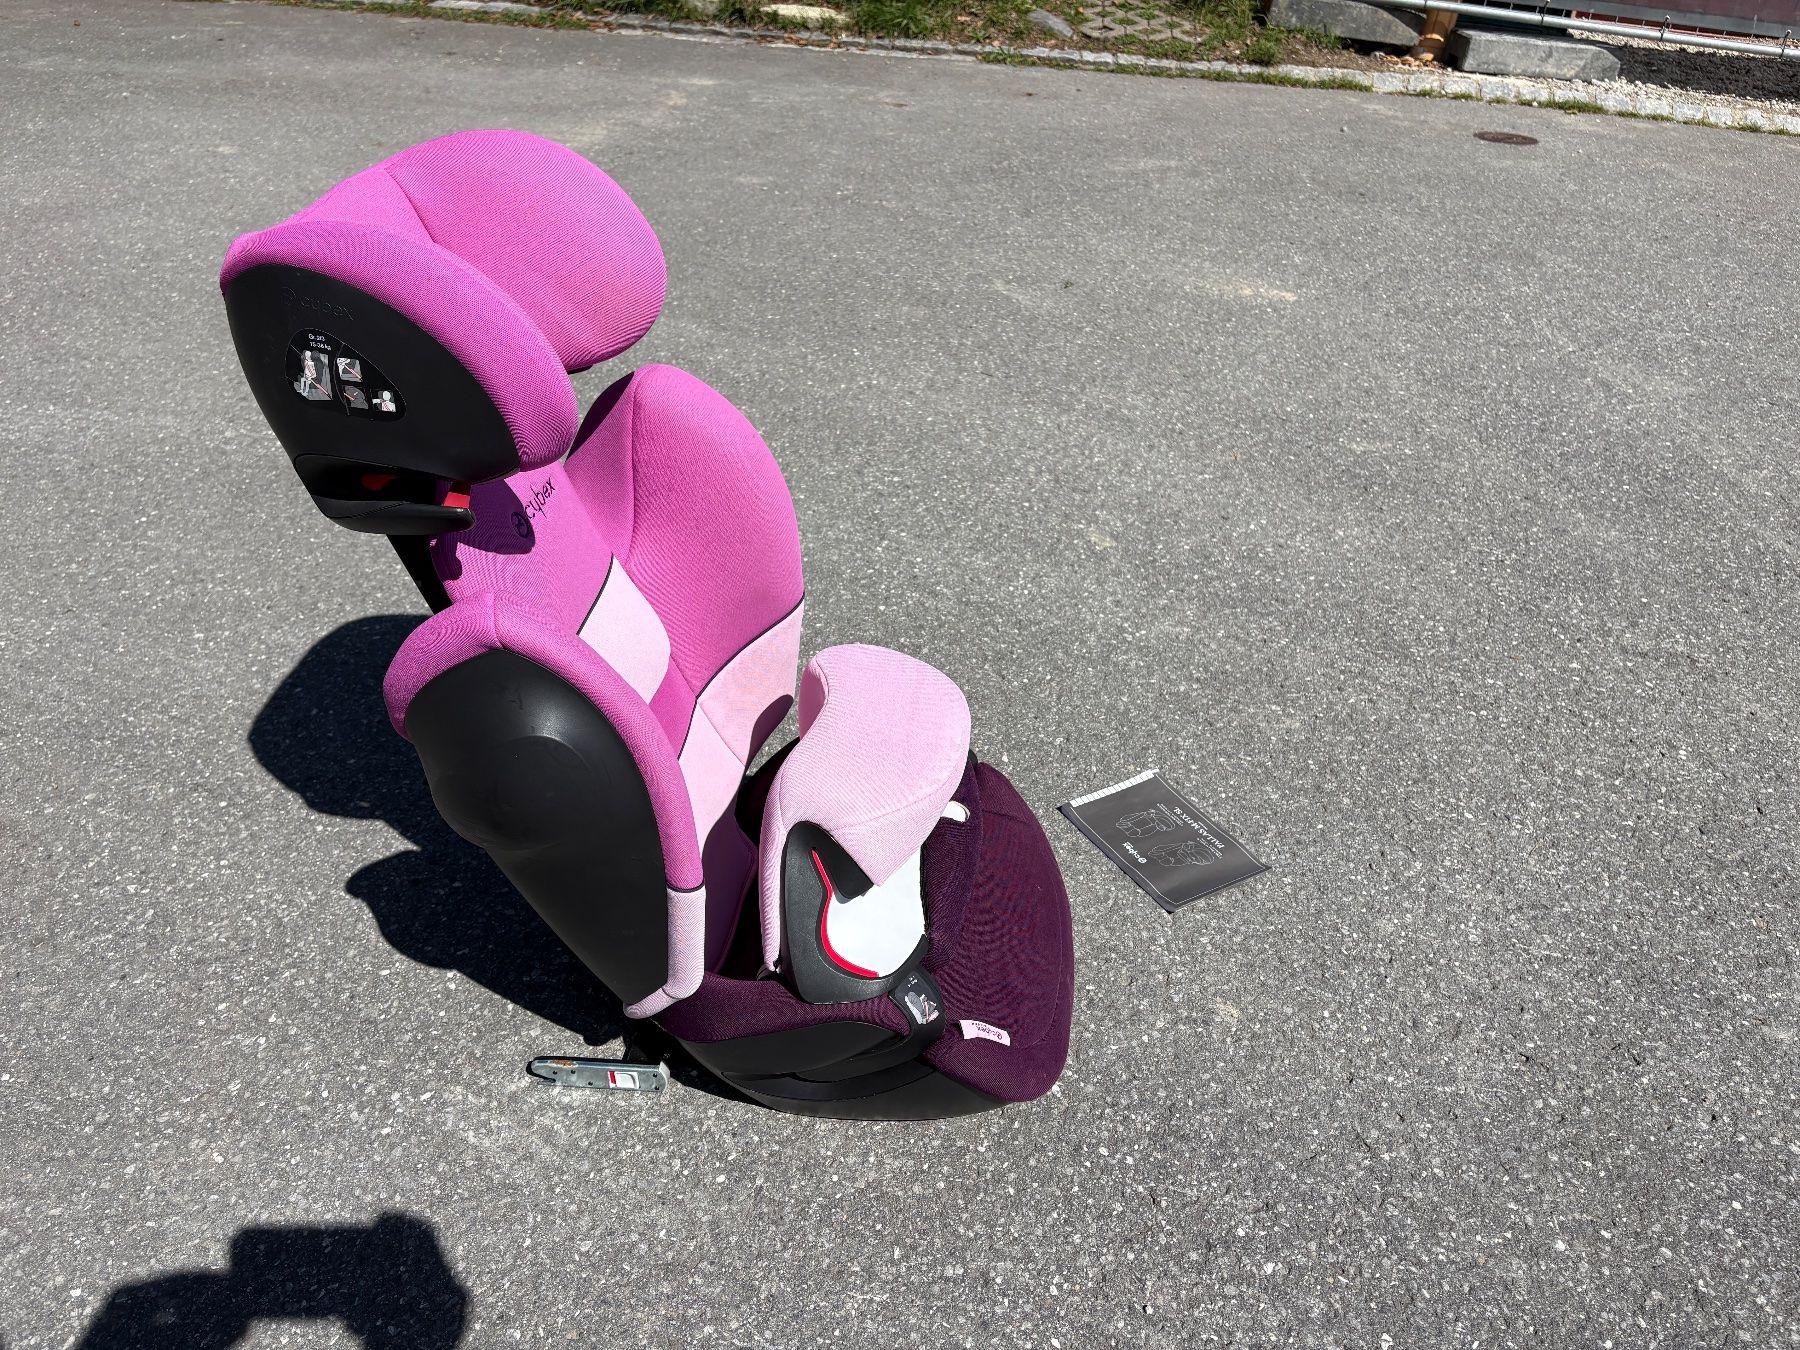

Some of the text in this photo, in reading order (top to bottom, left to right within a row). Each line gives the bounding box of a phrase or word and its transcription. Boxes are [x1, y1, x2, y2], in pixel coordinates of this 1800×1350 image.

[525, 477, 556, 519] cybex
[1173, 806, 1183, 815] SL
[1198, 828, 1225, 849] PALLAS
[1122, 842, 1140, 859] cybex
